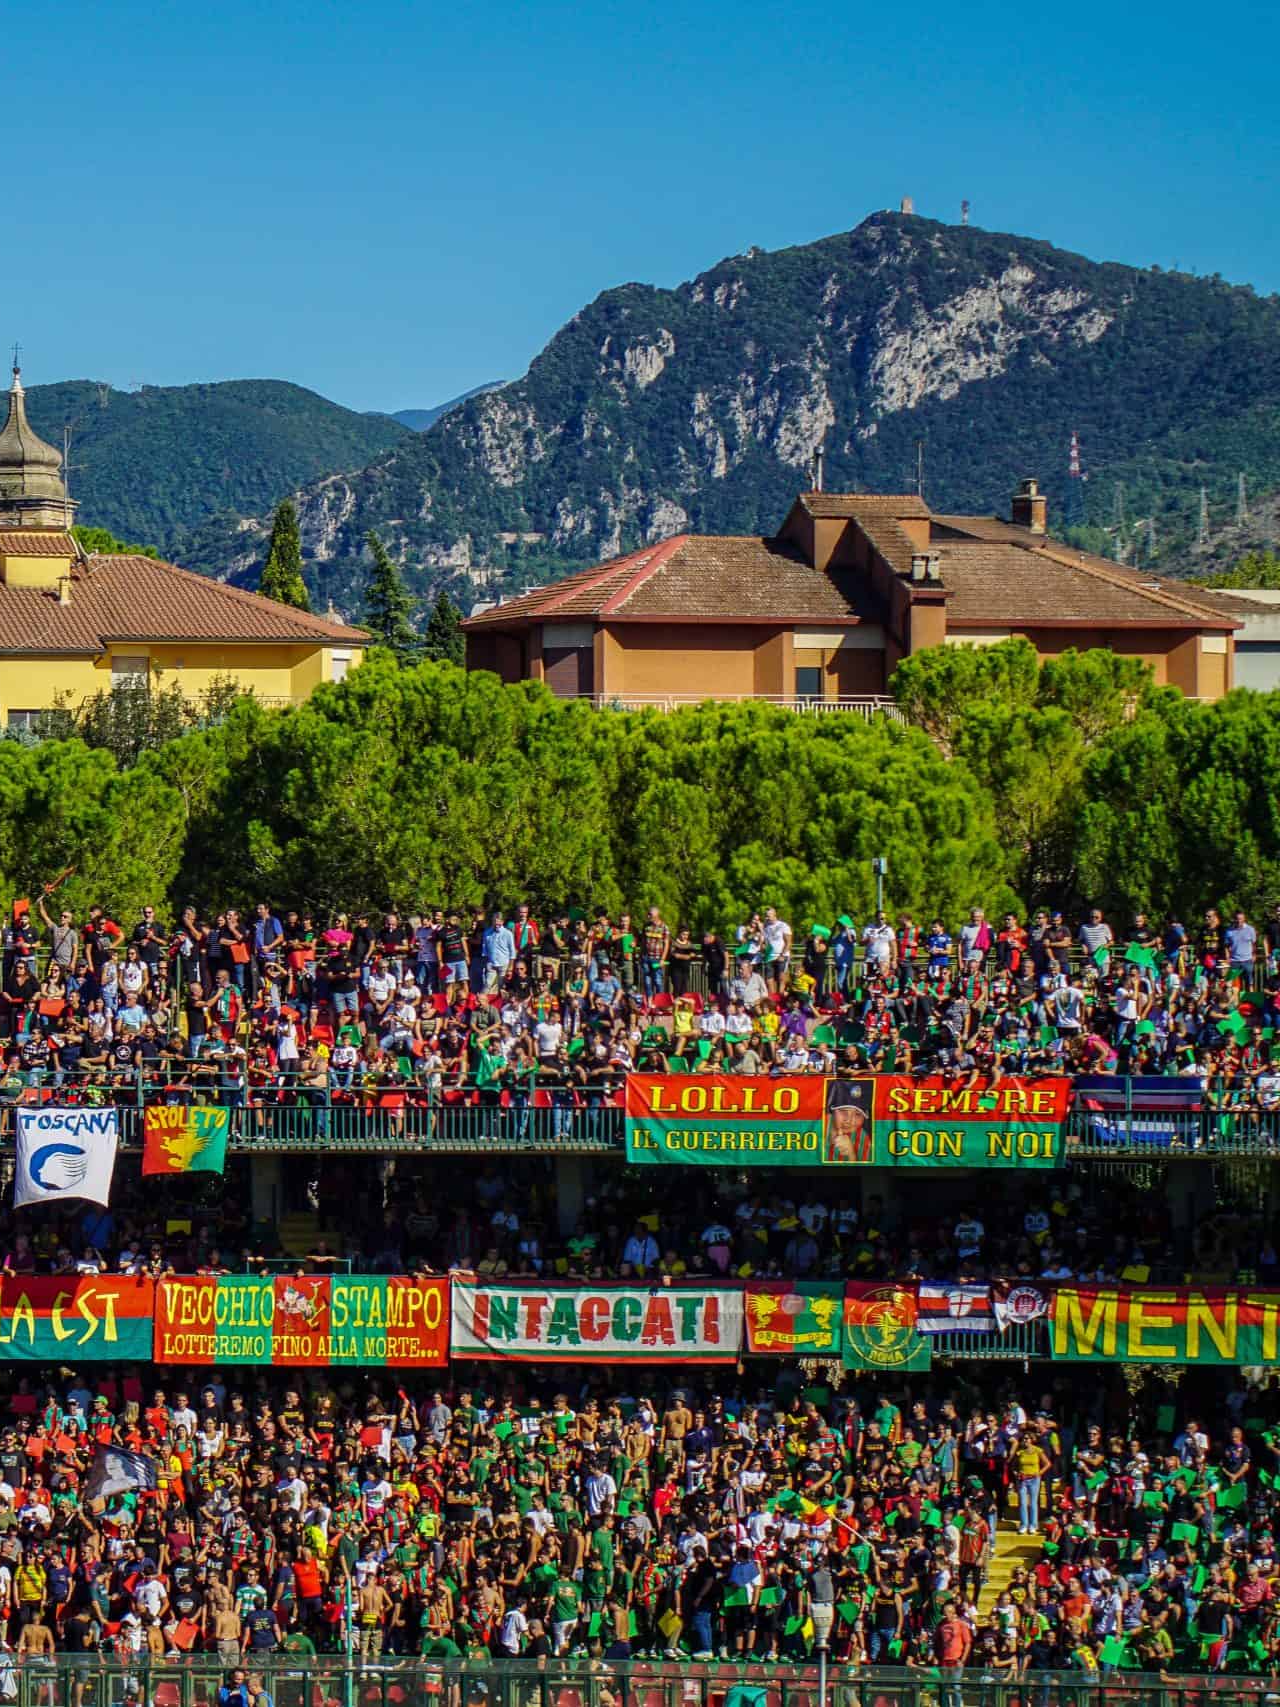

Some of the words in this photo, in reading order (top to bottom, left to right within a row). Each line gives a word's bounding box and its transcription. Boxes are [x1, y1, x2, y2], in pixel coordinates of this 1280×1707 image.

[650, 1086, 800, 1113] LOLLO
[888, 1088, 1057, 1114] SEMPRE
[19, 1110, 117, 1136] TOSCANA
[145, 1106, 226, 1130] SPOLETO
[632, 1129, 658, 1149] IL
[666, 1130, 818, 1151] GUERRIERO
[888, 1130, 964, 1157] CON
[987, 1132, 1055, 1158] NOI
[51, 1288, 120, 1346] EST
[163, 1283, 275, 1327] VECCHIO
[331, 1286, 443, 1329] STAMPO
[472, 1293, 720, 1345] INTACCATI
[163, 1333, 265, 1357] LOTTEREMO
[271, 1335, 313, 1357] FINO
[316, 1335, 358, 1357] ALLA
[363, 1336, 440, 1359] MORTE...
